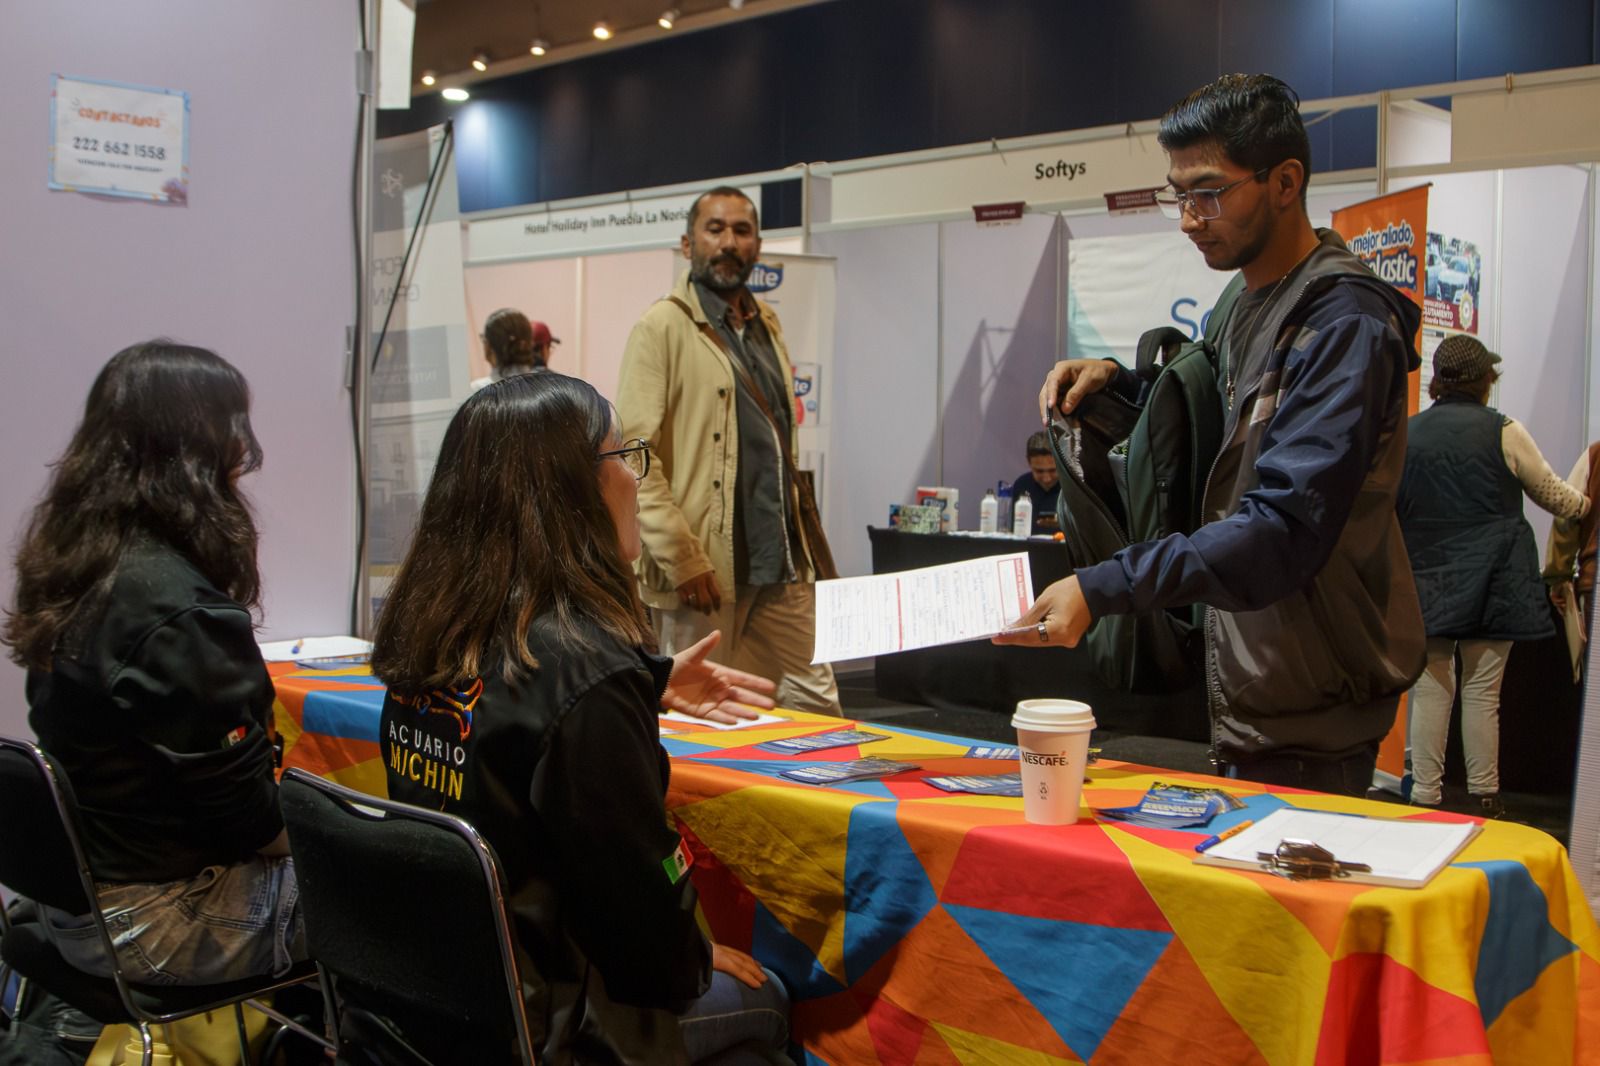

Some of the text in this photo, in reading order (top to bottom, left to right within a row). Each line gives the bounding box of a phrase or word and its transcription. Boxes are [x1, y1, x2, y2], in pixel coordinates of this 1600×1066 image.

[73, 136, 166, 160] 222 662 1558
[1035, 159, 1086, 180] Softys
[524, 221, 549, 235] Hotel
[552, 217, 588, 232] Holiday
[591, 216, 605, 228] Inn
[609, 212, 642, 226] Puebla
[645, 210, 657, 224] La
[1353, 230, 1381, 255] mejor
[389, 719, 466, 765] ACUARIO
[391, 741, 464, 801] MICHIN
